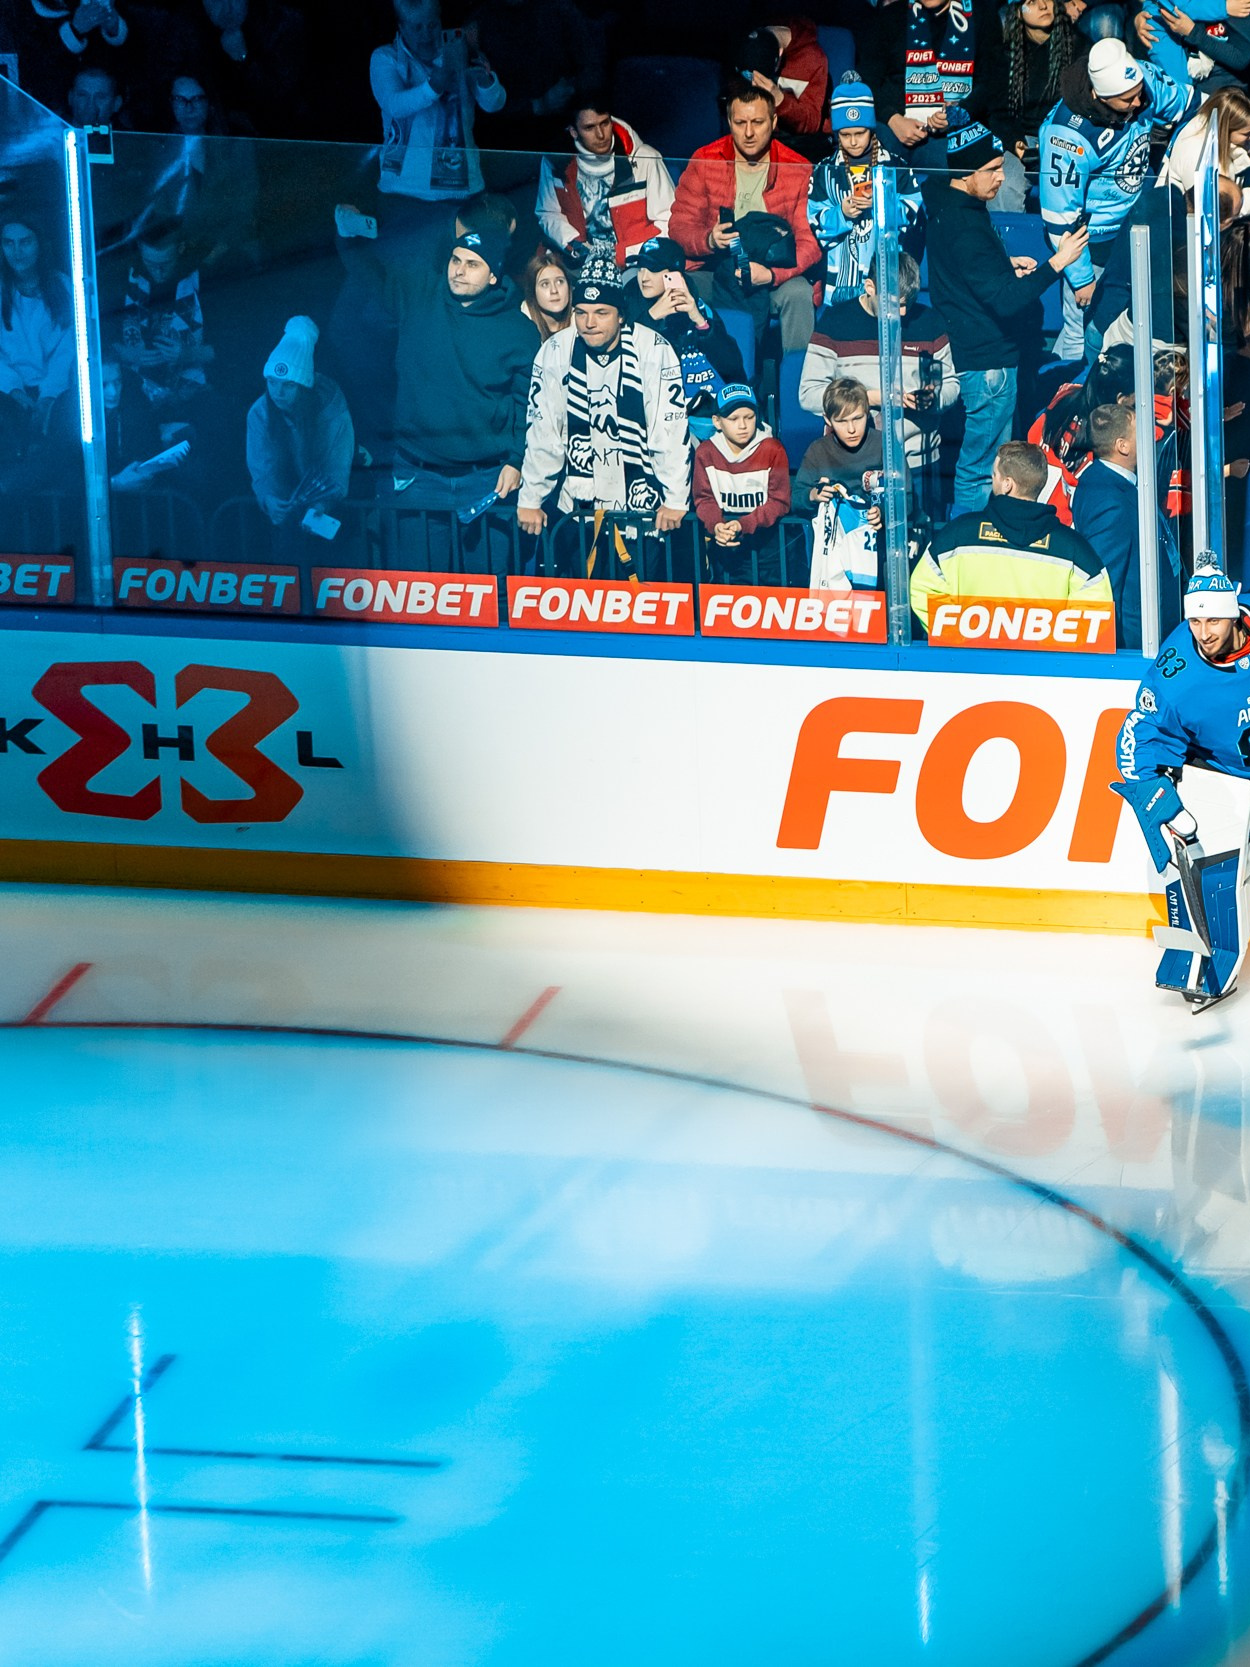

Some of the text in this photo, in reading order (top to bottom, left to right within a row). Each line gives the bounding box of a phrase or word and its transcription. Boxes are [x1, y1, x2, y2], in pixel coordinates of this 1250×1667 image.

[936, 62, 972, 72] FONBET
[1049, 152, 1081, 189] 54
[686, 369, 715, 383] 2025
[667, 383, 686, 409] 2
[118, 567, 296, 608] FONBET
[316, 577, 493, 618] FONBET
[511, 586, 690, 626] FONBET
[703, 594, 881, 634] FONBET
[931, 604, 1111, 644] FONBET
[1156, 646, 1188, 679] 83
